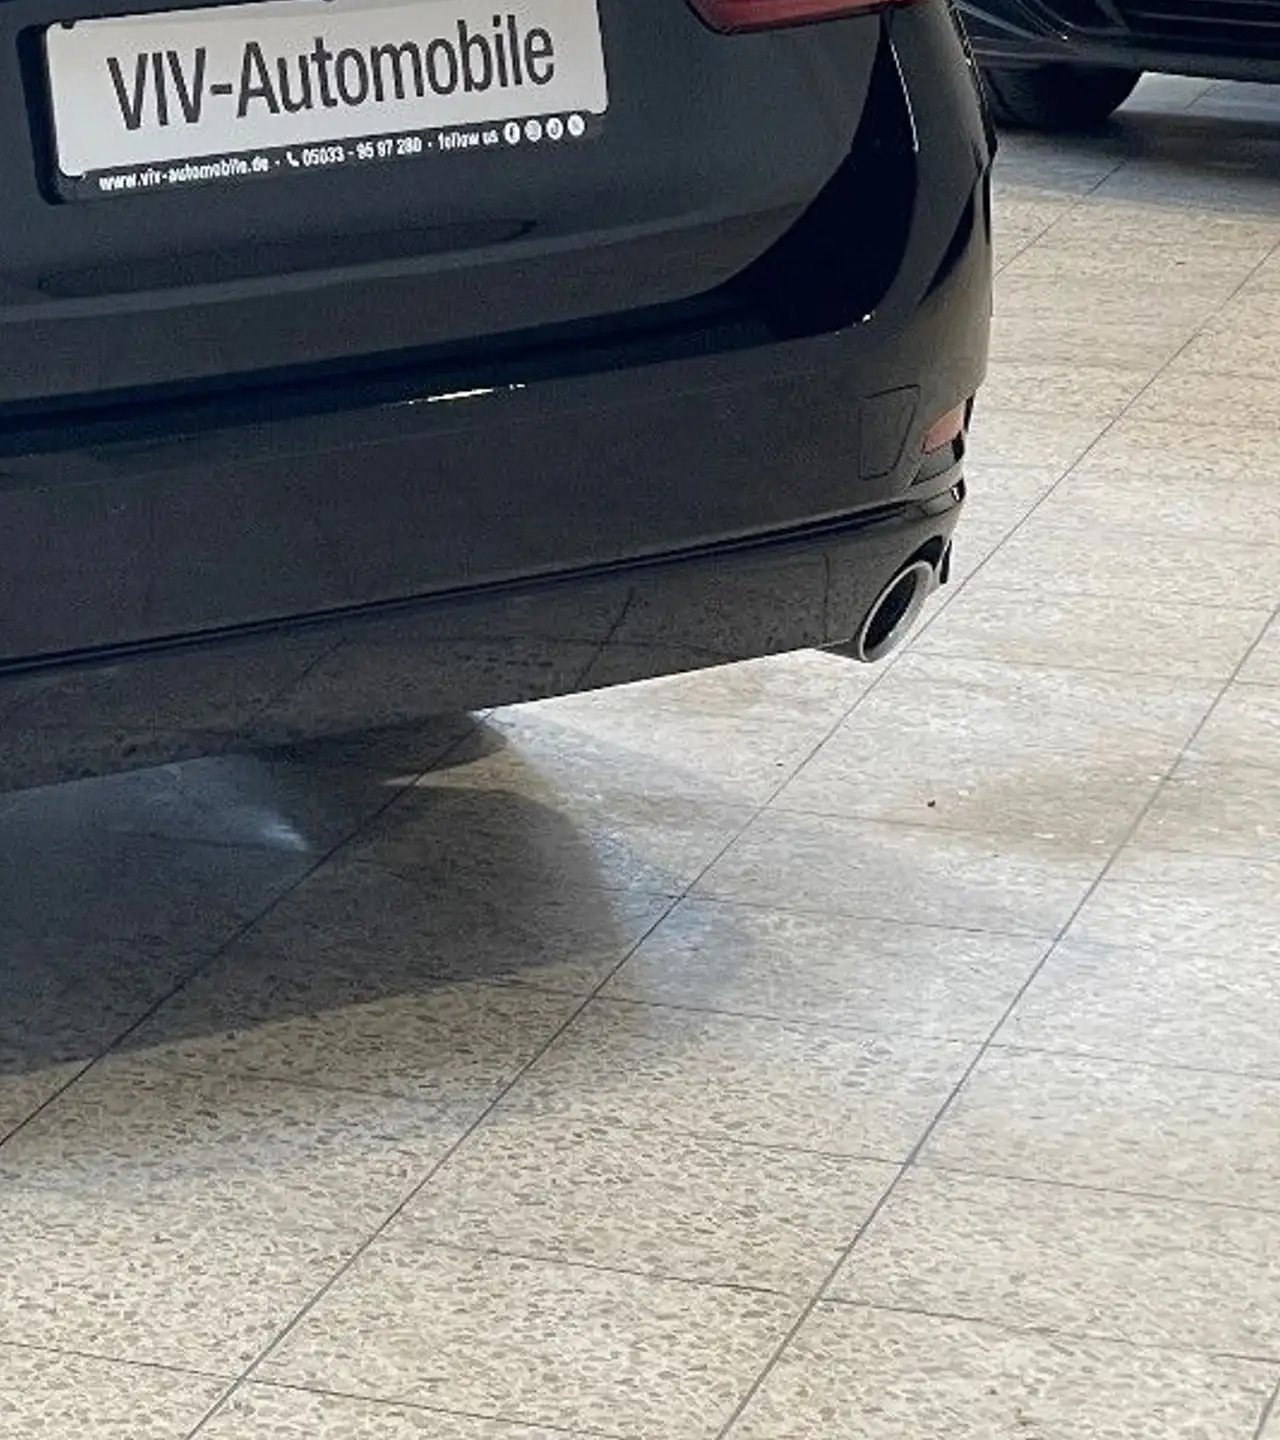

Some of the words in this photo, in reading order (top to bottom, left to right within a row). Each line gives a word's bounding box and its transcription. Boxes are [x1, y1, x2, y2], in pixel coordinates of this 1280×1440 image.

[106, 14, 555, 131] VIV-Automobile
[98, 156, 269, 191] www.viv-automobile.de
[482, 129, 499, 146] us
